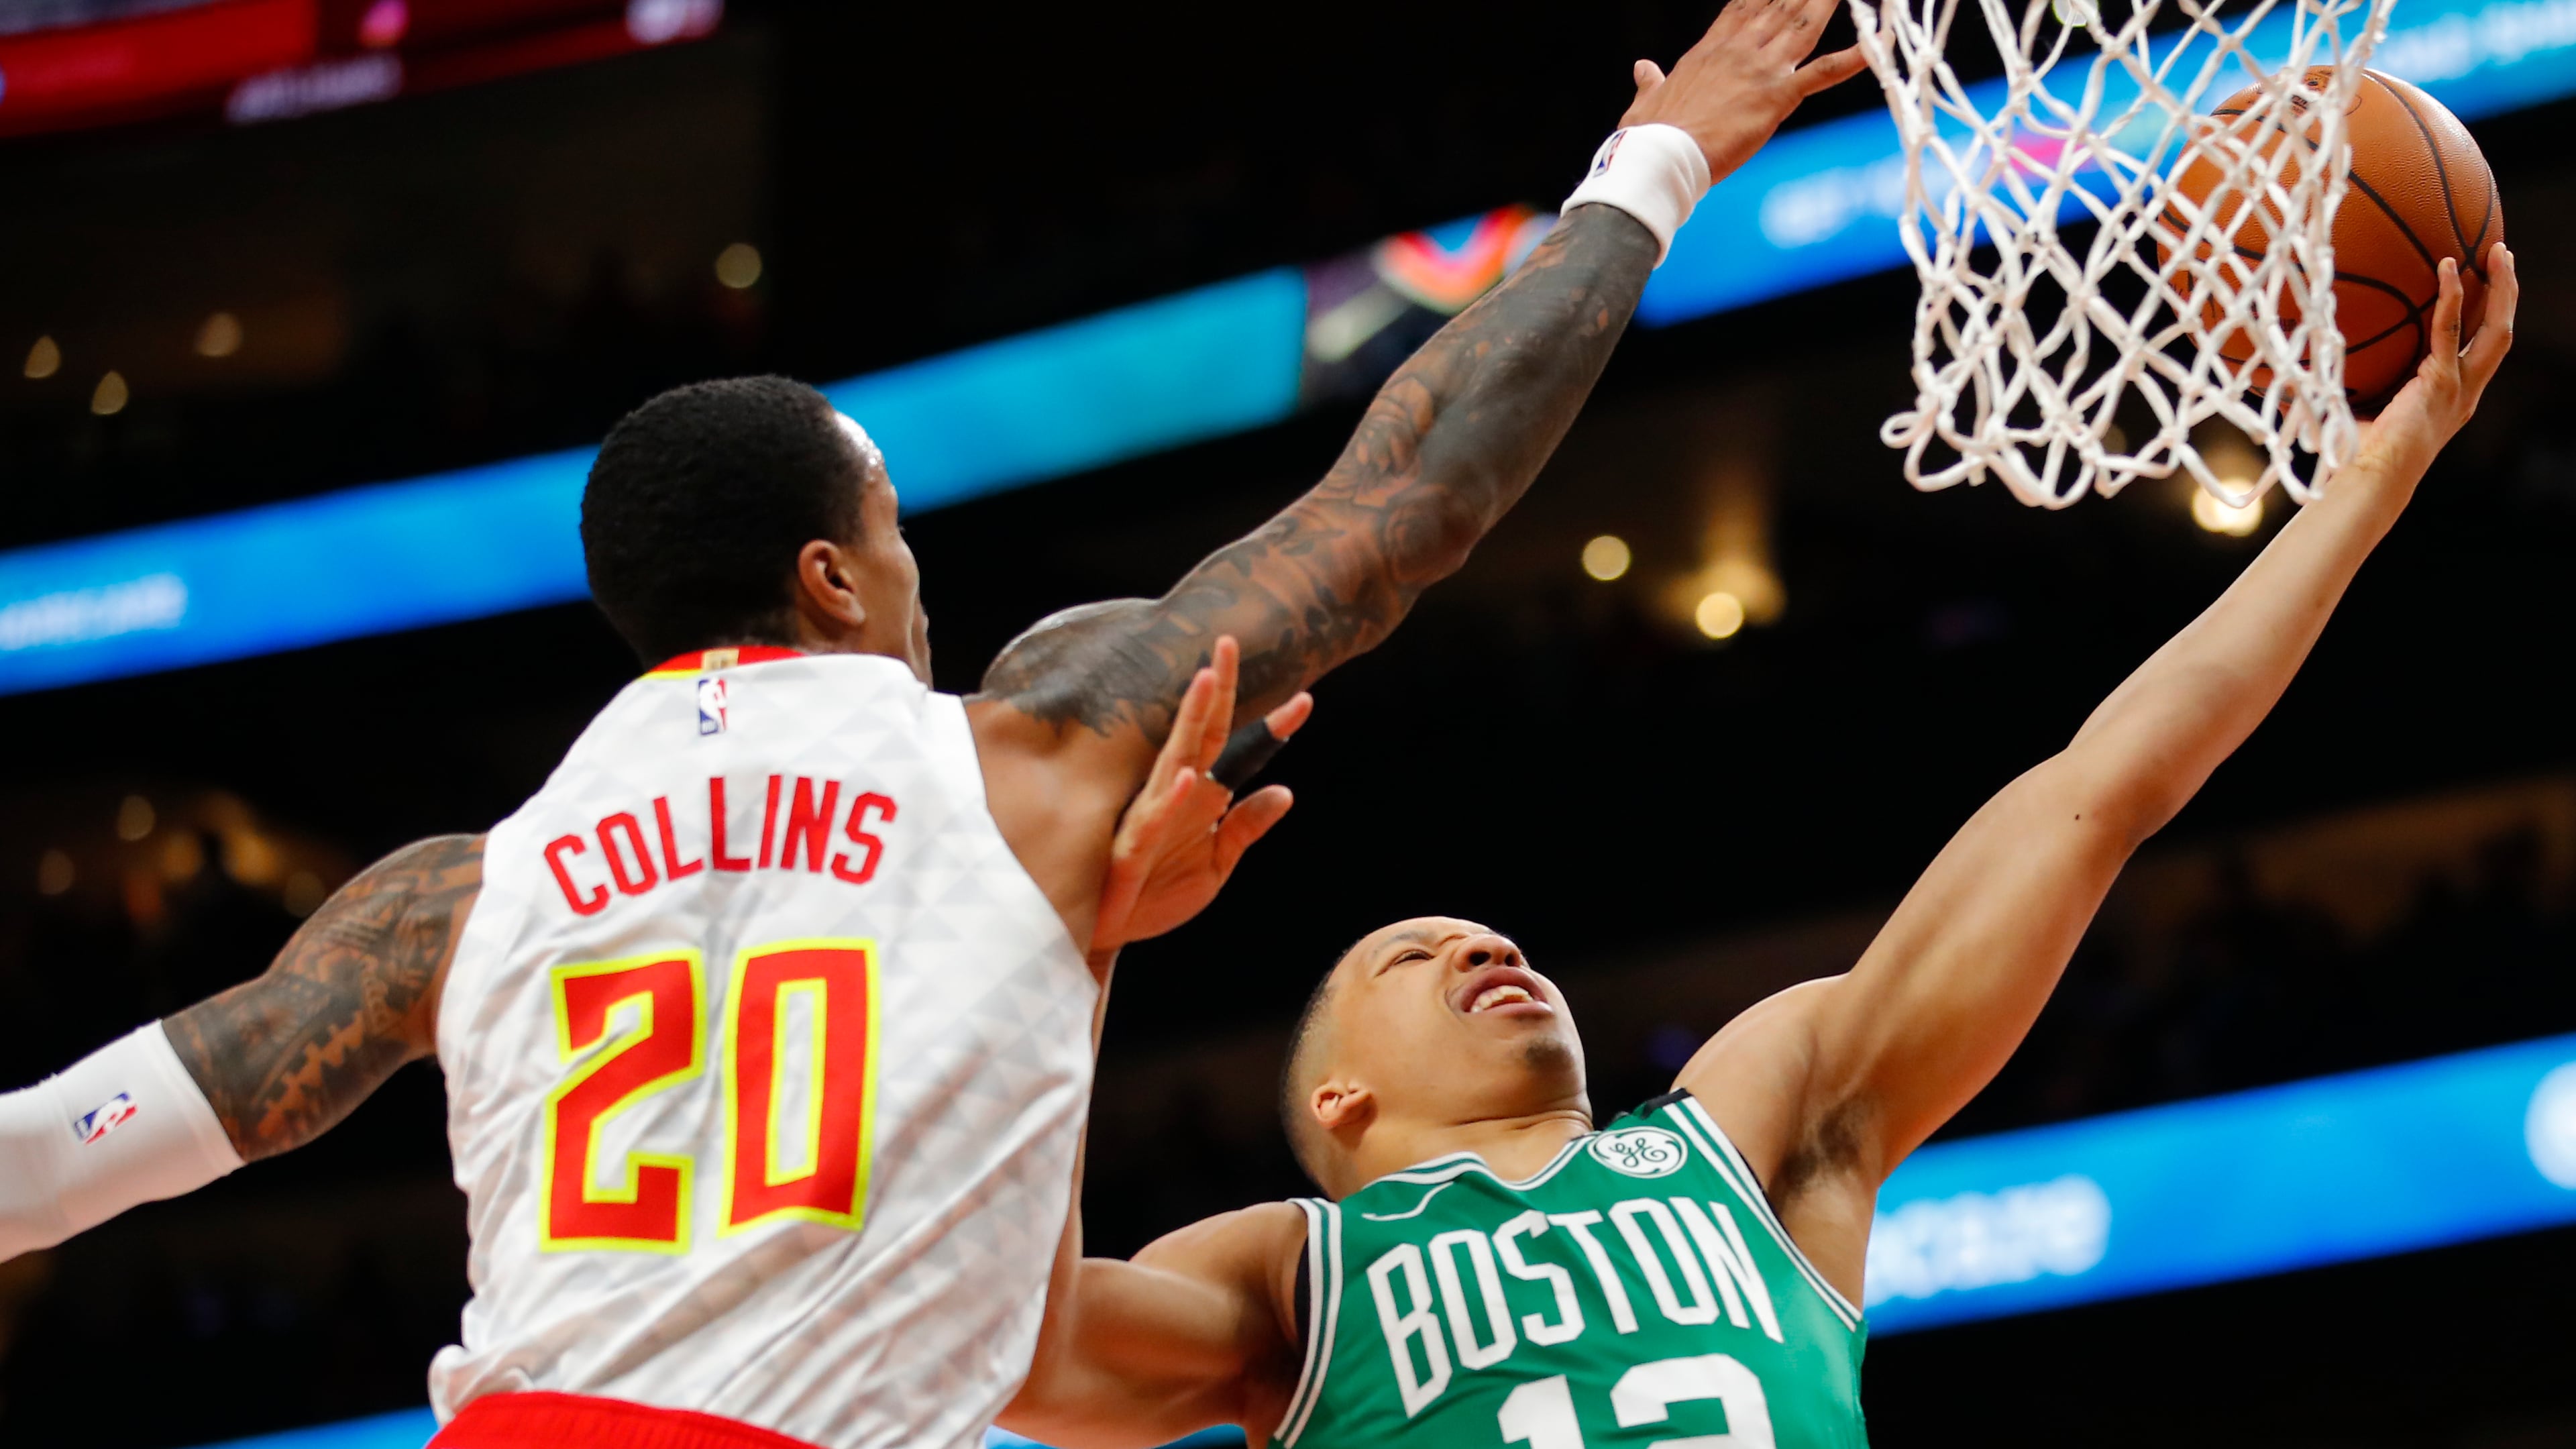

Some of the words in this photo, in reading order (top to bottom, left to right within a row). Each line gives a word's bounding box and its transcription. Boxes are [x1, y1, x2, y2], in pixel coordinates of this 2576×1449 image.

[543, 774, 898, 916] COLLINS
[539, 936, 881, 1255] 20
[1366, 1196, 1784, 1419] BOSTON
